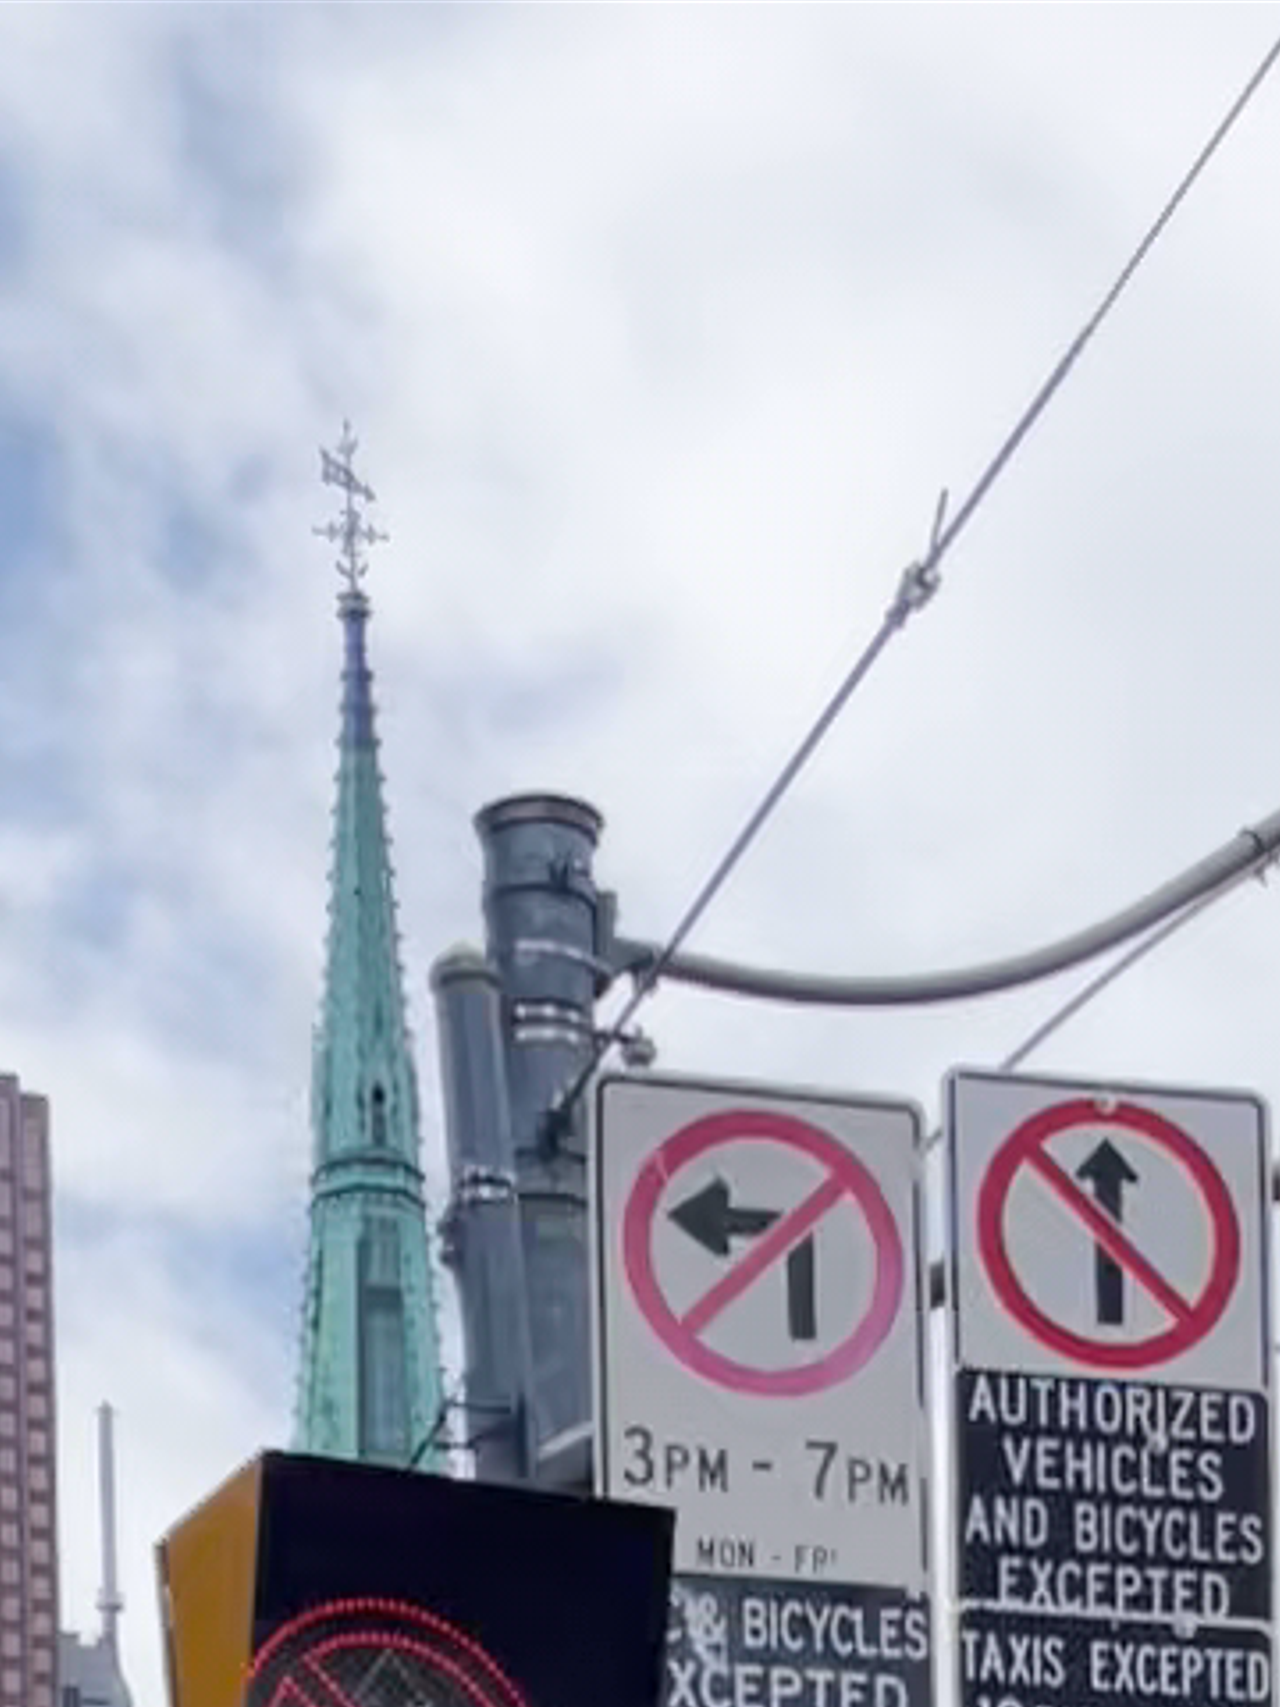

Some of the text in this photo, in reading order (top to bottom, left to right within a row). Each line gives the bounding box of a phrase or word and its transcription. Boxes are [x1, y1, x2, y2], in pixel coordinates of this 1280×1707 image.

[969, 1375, 1255, 1444] AUTHORIZED
[624, 1425, 729, 1493] 3PM
[805, 1440, 910, 1506] 7PM
[1002, 1434, 1224, 1500] VEHICLES
[697, 1536, 754, 1567] MON
[965, 1494, 1264, 1564] AND BICYCLES
[999, 1556, 1230, 1620] EXCEPTED
[742, 1597, 928, 1661] BICYCLES
[961, 1630, 1269, 1699] TAXIS EXCEPTED
